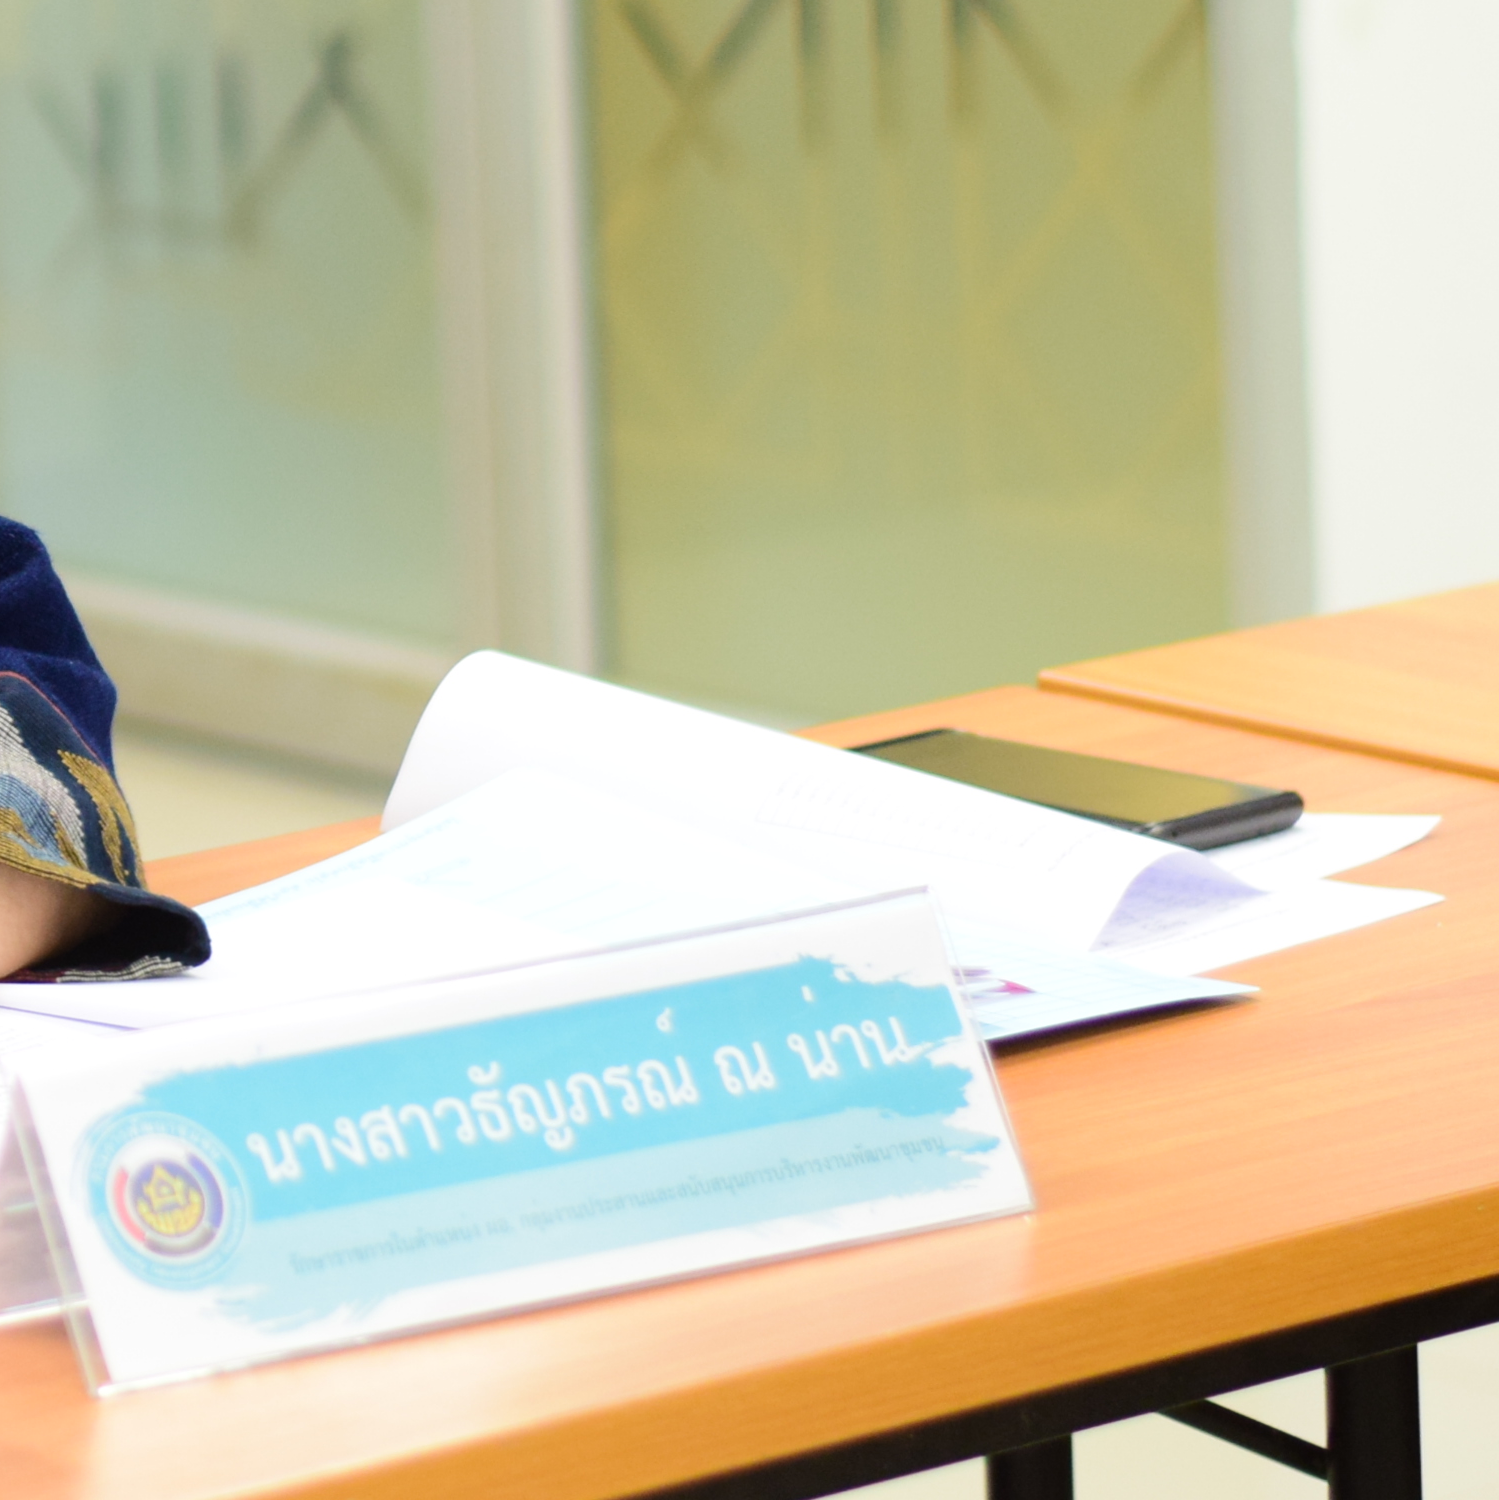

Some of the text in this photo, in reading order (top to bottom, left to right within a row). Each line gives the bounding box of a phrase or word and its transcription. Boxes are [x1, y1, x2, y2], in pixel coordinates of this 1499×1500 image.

[246, 1007, 699, 1182] นางสาวธัญภรณ์
[713, 1041, 776, 1096] ณ
[785, 985, 916, 1080] น่าน
